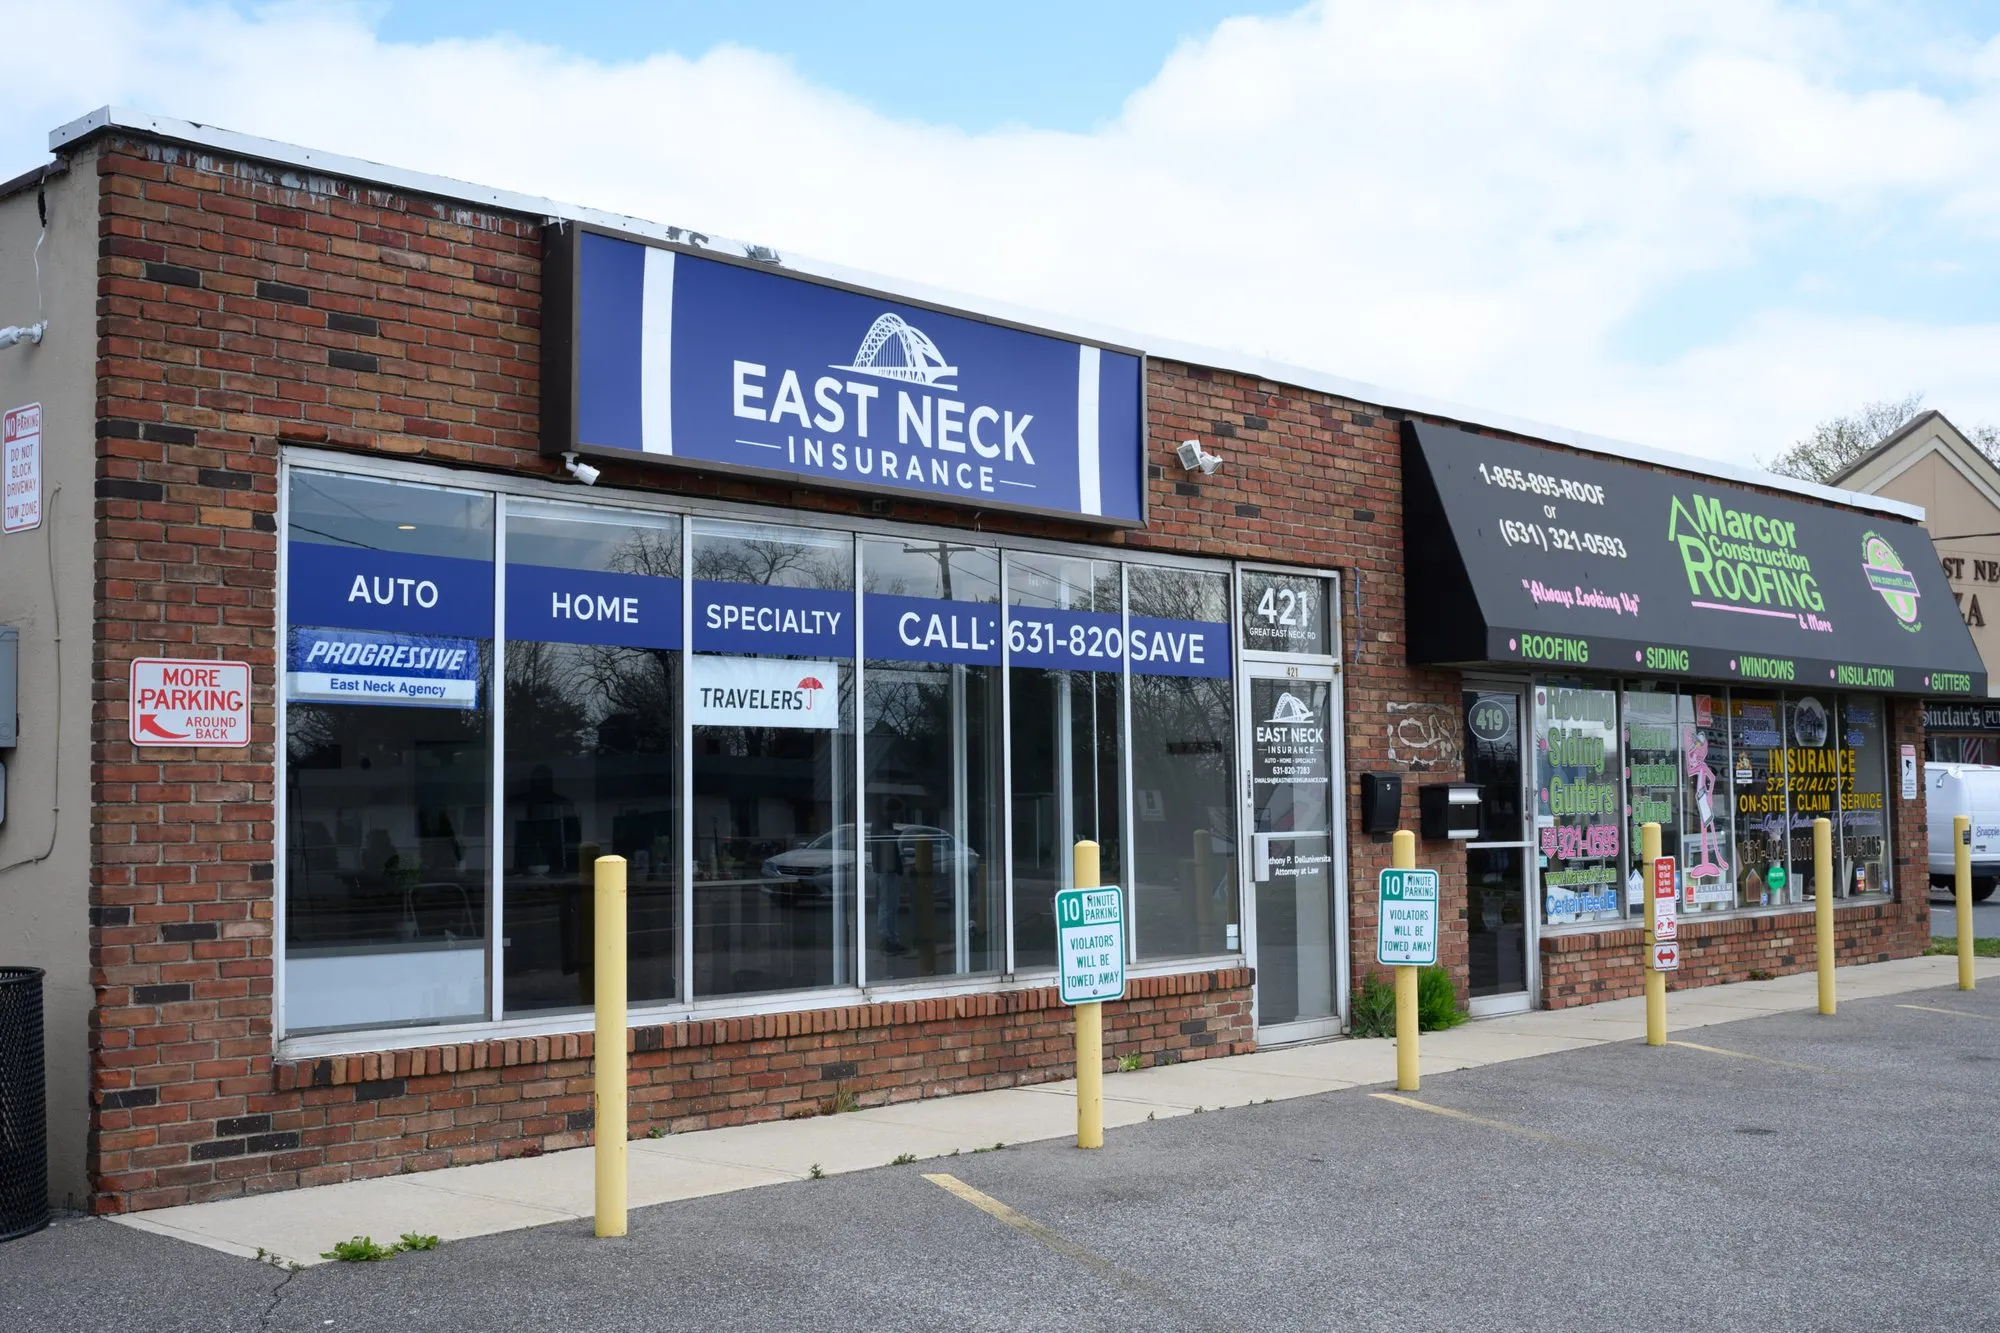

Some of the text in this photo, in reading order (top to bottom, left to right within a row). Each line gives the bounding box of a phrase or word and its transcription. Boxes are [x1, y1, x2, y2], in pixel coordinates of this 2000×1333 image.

[733, 360, 1036, 465] EAST NECK
[5, 413, 39, 437] NO PARKING
[10, 444, 34, 462] DO NOT
[11, 461, 32, 479] BLOCK
[789, 435, 995, 493] INSURANCE
[6, 478, 37, 498] DRIVEWAY
[1479, 463, 1605, 505] 1-855-895-ROOF
[6, 501, 38, 520] TOW ZONE
[1544, 505, 1556, 518] or
[1693, 494, 1797, 549] Marcor
[1499, 519, 1627, 558] (631) 321-0593
[1709, 535, 1811, 572] Construction
[1677, 534, 1825, 612] ROOFING
[1973, 559, 2000, 582] NE
[348, 574, 439, 609] AUTO
[1575, 586, 1622, 615] Looking
[552, 592, 639, 624] HOME
[1257, 587, 1309, 627] 421
[706, 603, 842, 635] SPECIALTY
[1807, 613, 1833, 632] More
[898, 611, 996, 651] CALL:
[1249, 627, 1271, 637] GREAT
[1271, 629, 1288, 638] EAST
[306, 640, 467, 672] PROGRESSIVE
[1521, 635, 1588, 663] ROOFING
[1646, 647, 1689, 671] SIDING
[163, 668, 221, 687] MORE
[1287, 666, 1298, 678] 421
[1740, 656, 1795, 681] WINDOWS
[1838, 665, 1894, 688] INSULATION
[310, 678, 447, 698] East Neck Agency
[1931, 672, 1971, 692] GUTTERS
[140, 688, 241, 712] PARKING
[700, 687, 804, 711] TRAVELERS
[185, 716, 237, 728] AROUND
[1476, 709, 1504, 731] 419
[1984, 710, 2000, 725] PU
[195, 728, 228, 739] BACK
[1256, 727, 1324, 744] EAST NECK
[1267, 746, 1315, 755] INSURANCE
[1548, 727, 1605, 775] Siding
[1768, 748, 1856, 774] INSURANCE
[1767, 776, 1855, 793] SPECIALISTS
[1550, 775, 1614, 816] Gutters
[1739, 793, 1882, 813] ON-SITE CLAIM SERVICE
[1557, 824, 1620, 860] 321-0593
[1275, 866, 1300, 877] Attorney
[1307, 866, 1320, 875] Law
[1407, 876, 1432, 887] MINUTE
[1384, 876, 1401, 895] 10
[1404, 886, 1433, 897] PARKING
[1062, 897, 1080, 922] 10
[1087, 894, 1115, 907] MINUTE
[1085, 907, 1118, 921] PARKING
[1389, 909, 1429, 921] VIOLATORS
[1394, 926, 1424, 937] WILL BE
[1070, 935, 1114, 951] VIOLATORS
[1384, 940, 1432, 952] TOWED AWAY
[1076, 954, 1110, 968] WILL BE
[1067, 971, 1120, 989] TOWED AWAY
